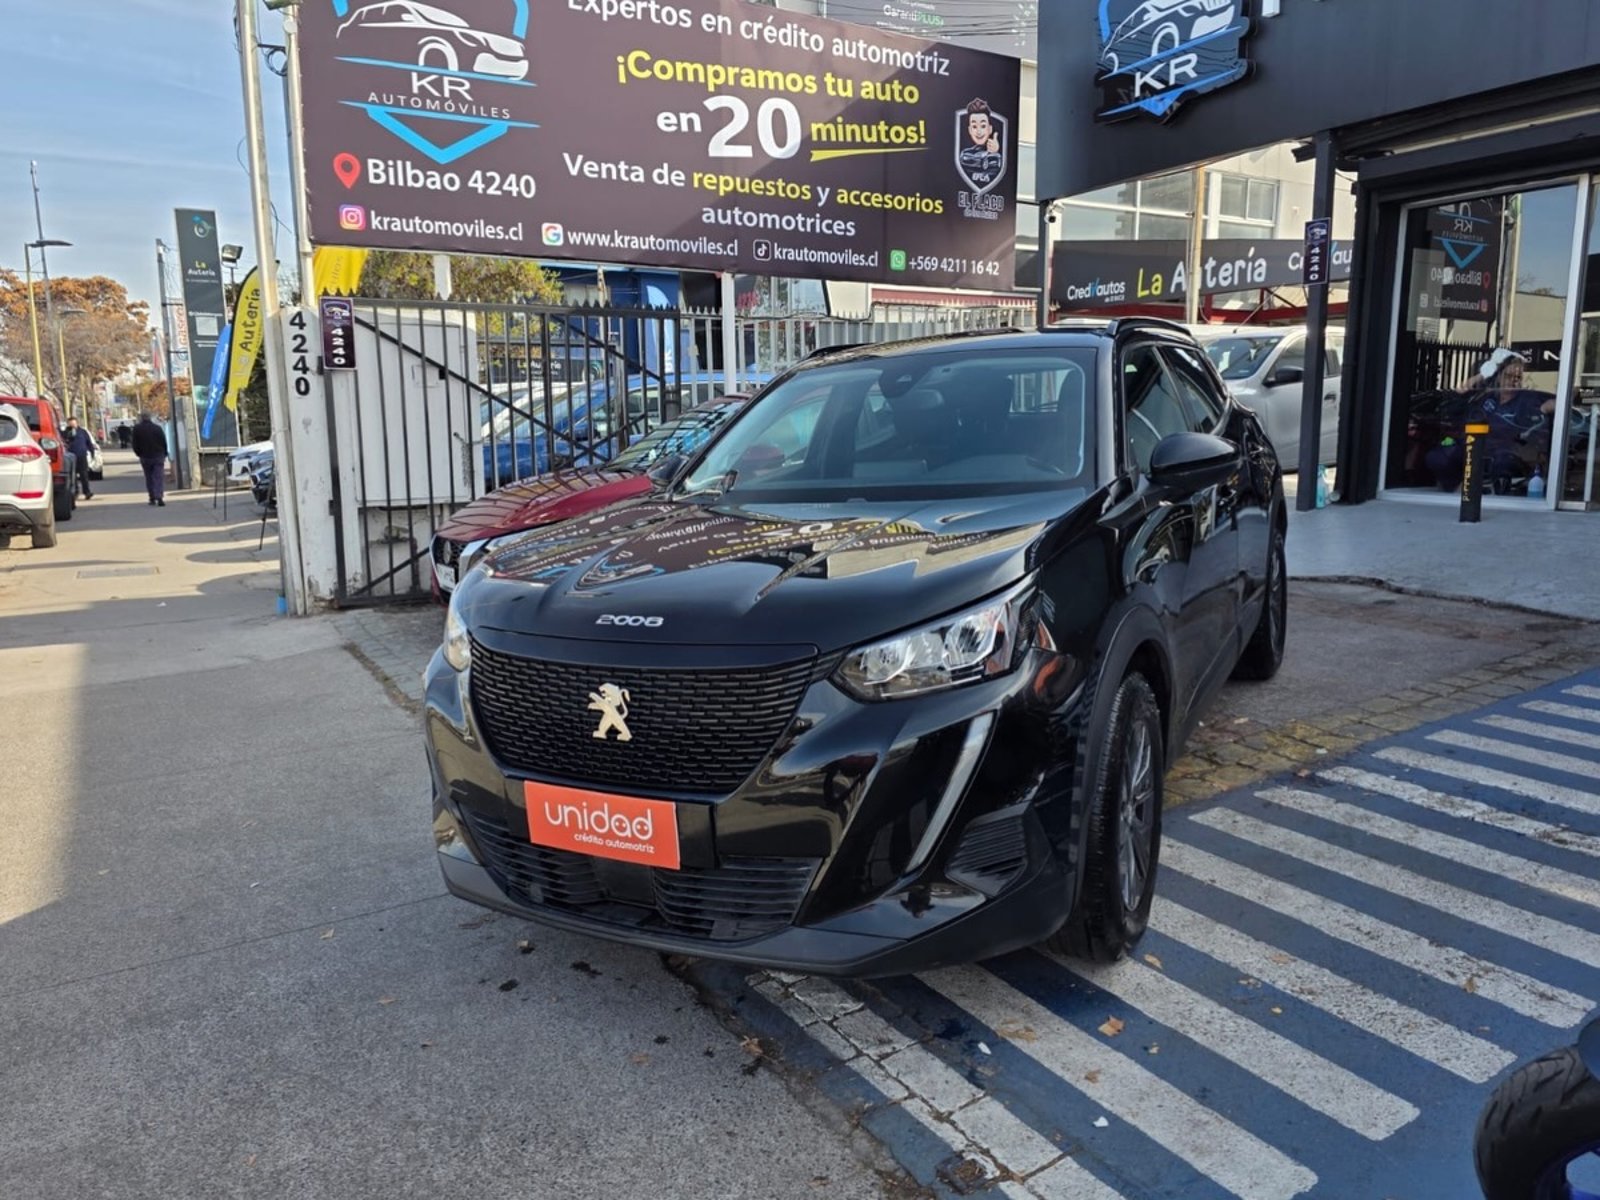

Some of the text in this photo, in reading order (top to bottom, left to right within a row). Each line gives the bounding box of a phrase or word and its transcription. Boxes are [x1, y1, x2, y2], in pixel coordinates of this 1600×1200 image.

[700, 13, 732, 35] en
[739, 15, 824, 52] crédito
[832, 38, 950, 76] automotriz
[411, 72, 473, 101] KR
[616, 49, 919, 104] ¡Compramos tu auto
[1134, 53, 1198, 97] KR
[368, 91, 511, 120] AUTOMÓVILES
[656, 95, 927, 159] en 20 minutos!
[367, 158, 537, 199] Bilbao 4240
[562, 153, 944, 214] Venta de repuestos y accesorios
[370, 210, 523, 242] krautomoviles.cl
[701, 205, 857, 237] automotrices
[567, 227, 739, 257] www.krautomoviles.cl
[774, 243, 879, 268] krautomoviles.cl
[908, 256, 938, 272] +569
[940, 257, 967, 274] 4211
[1137, 267, 1163, 298] La
[1171, 246, 1267, 293] Atería
[289, 310, 311, 396] 4240
[330, 327, 346, 365] 4240
[595, 614, 665, 628] 2008
[545, 800, 654, 841] unidad
[574, 831, 655, 854] crédito automotriz
